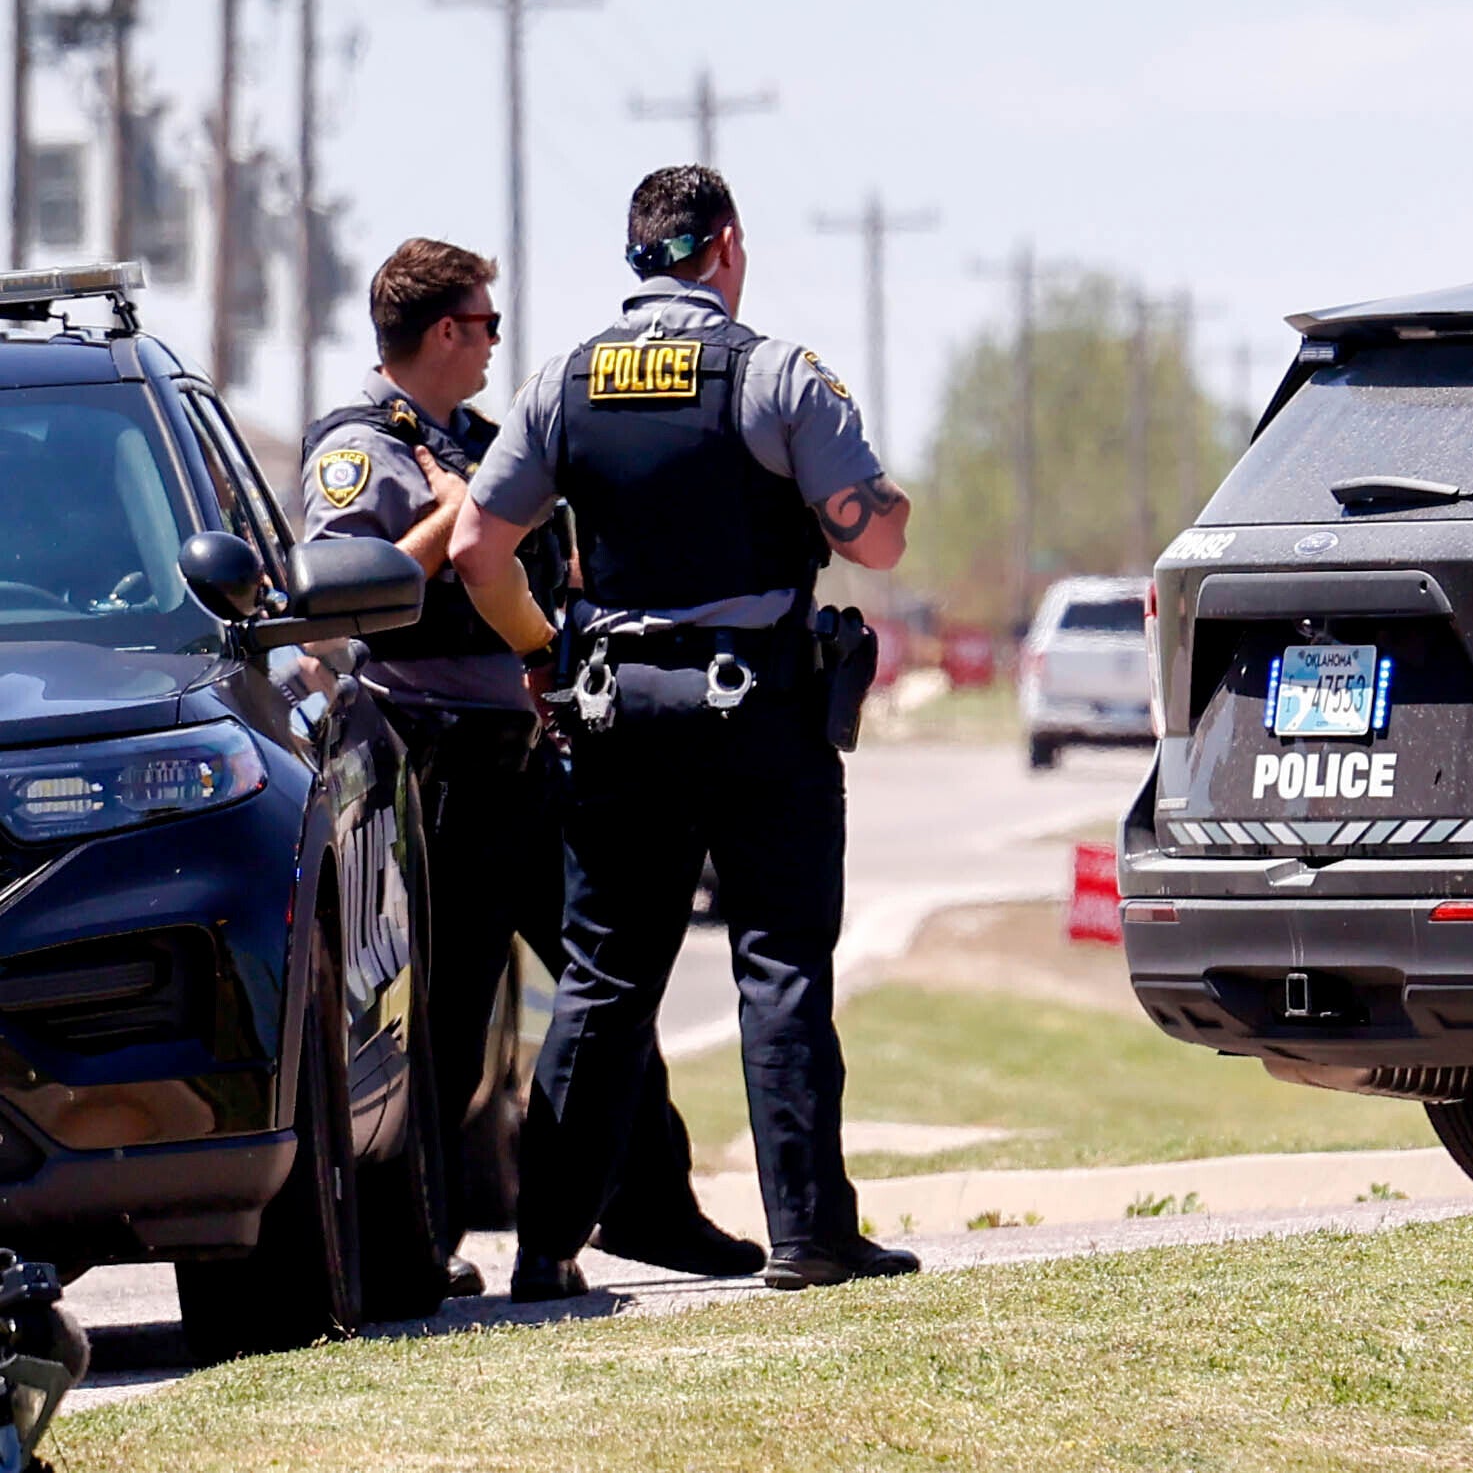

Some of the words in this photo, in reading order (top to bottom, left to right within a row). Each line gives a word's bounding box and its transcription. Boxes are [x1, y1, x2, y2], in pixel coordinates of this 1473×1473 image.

[597, 347, 692, 392] POLICE
[322, 453, 364, 467] POLICE
[1305, 653, 1353, 669] OKLAHOMA
[1252, 752, 1398, 800] POLICE
